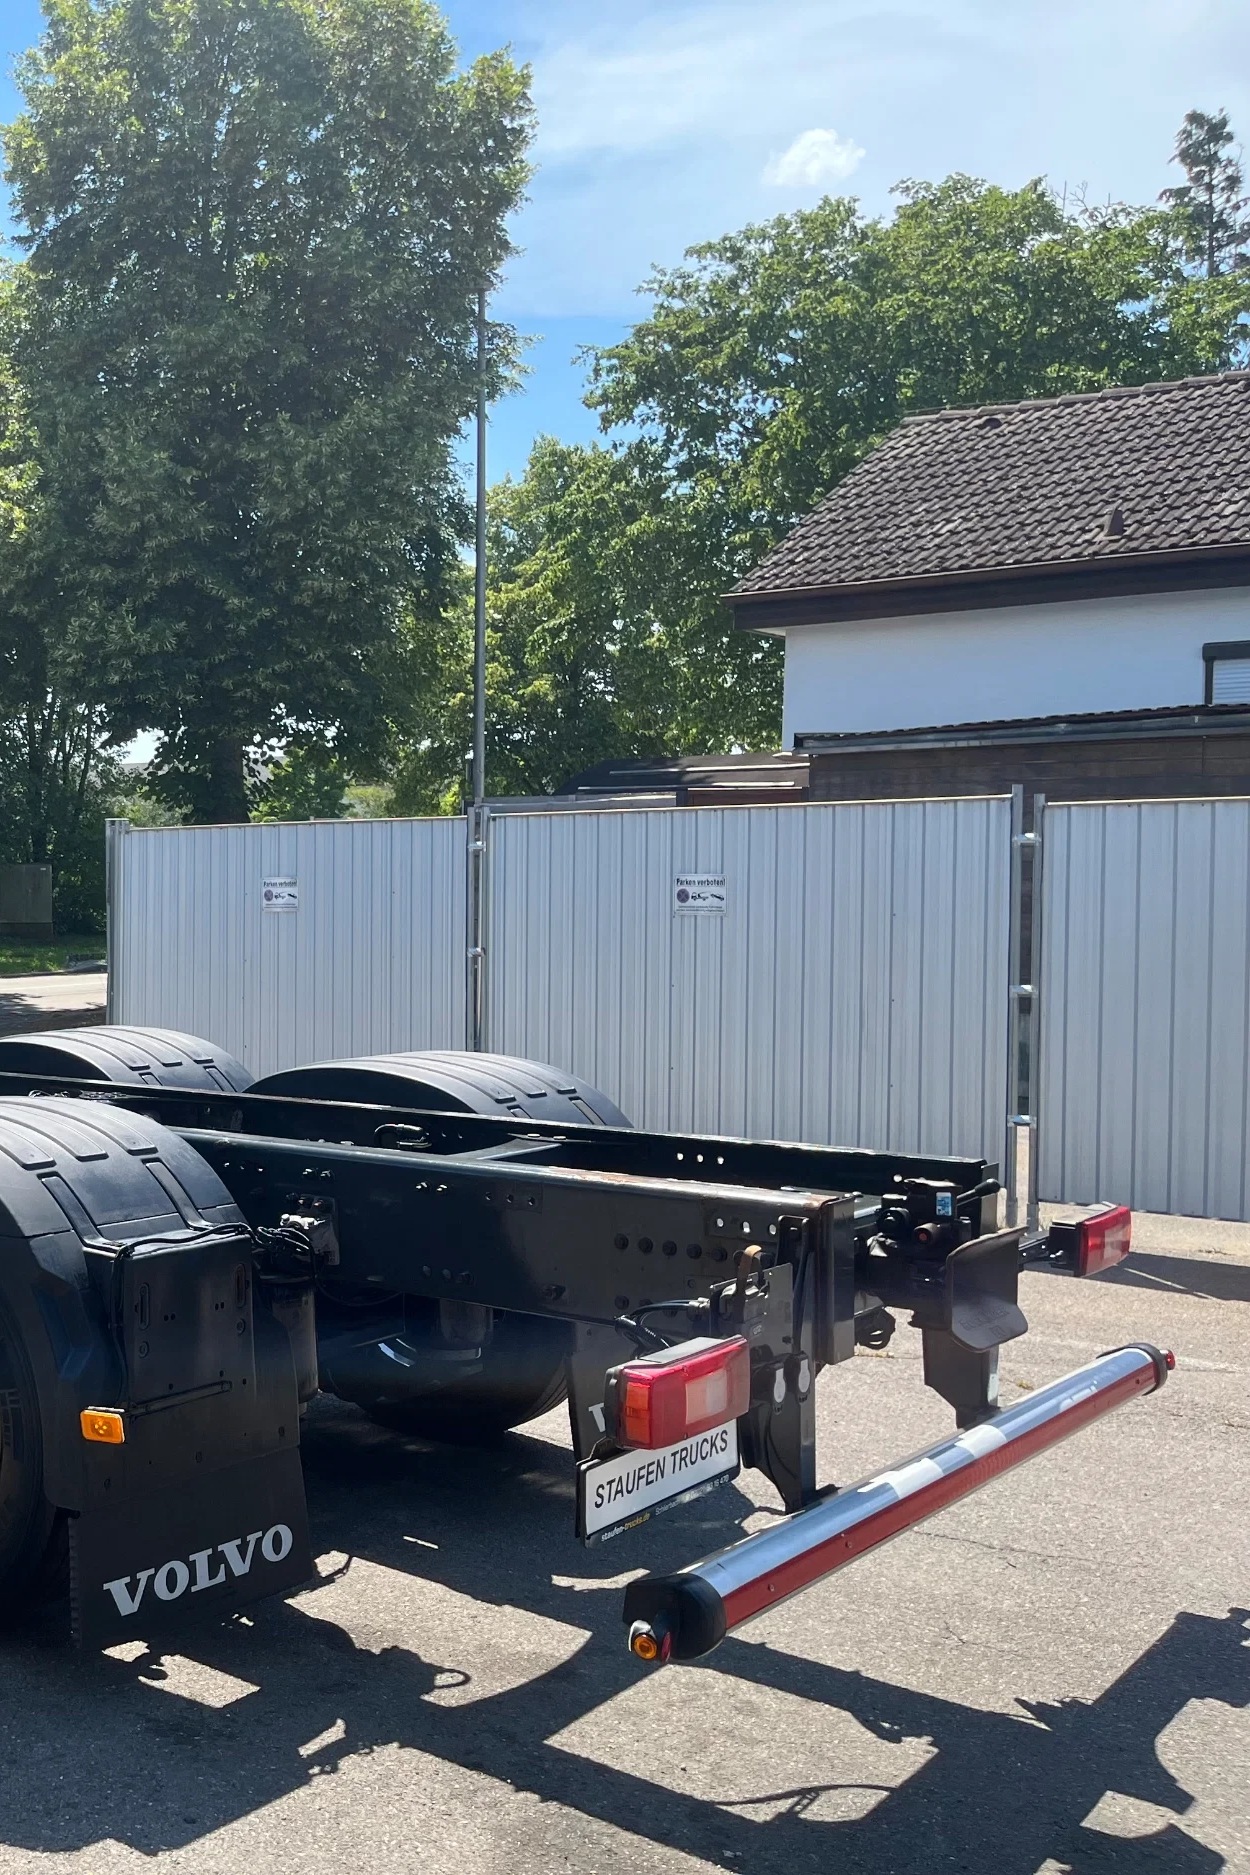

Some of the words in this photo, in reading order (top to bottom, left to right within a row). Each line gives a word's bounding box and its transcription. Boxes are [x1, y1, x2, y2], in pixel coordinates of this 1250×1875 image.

[676, 877, 696, 886] Parken
[595, 1456, 666, 1509] STAUFEN
[670, 1429, 728, 1474] TRUCKS
[601, 1512, 650, 1541] staufen-trucks.de
[103, 1523, 293, 1617] VOLVO
